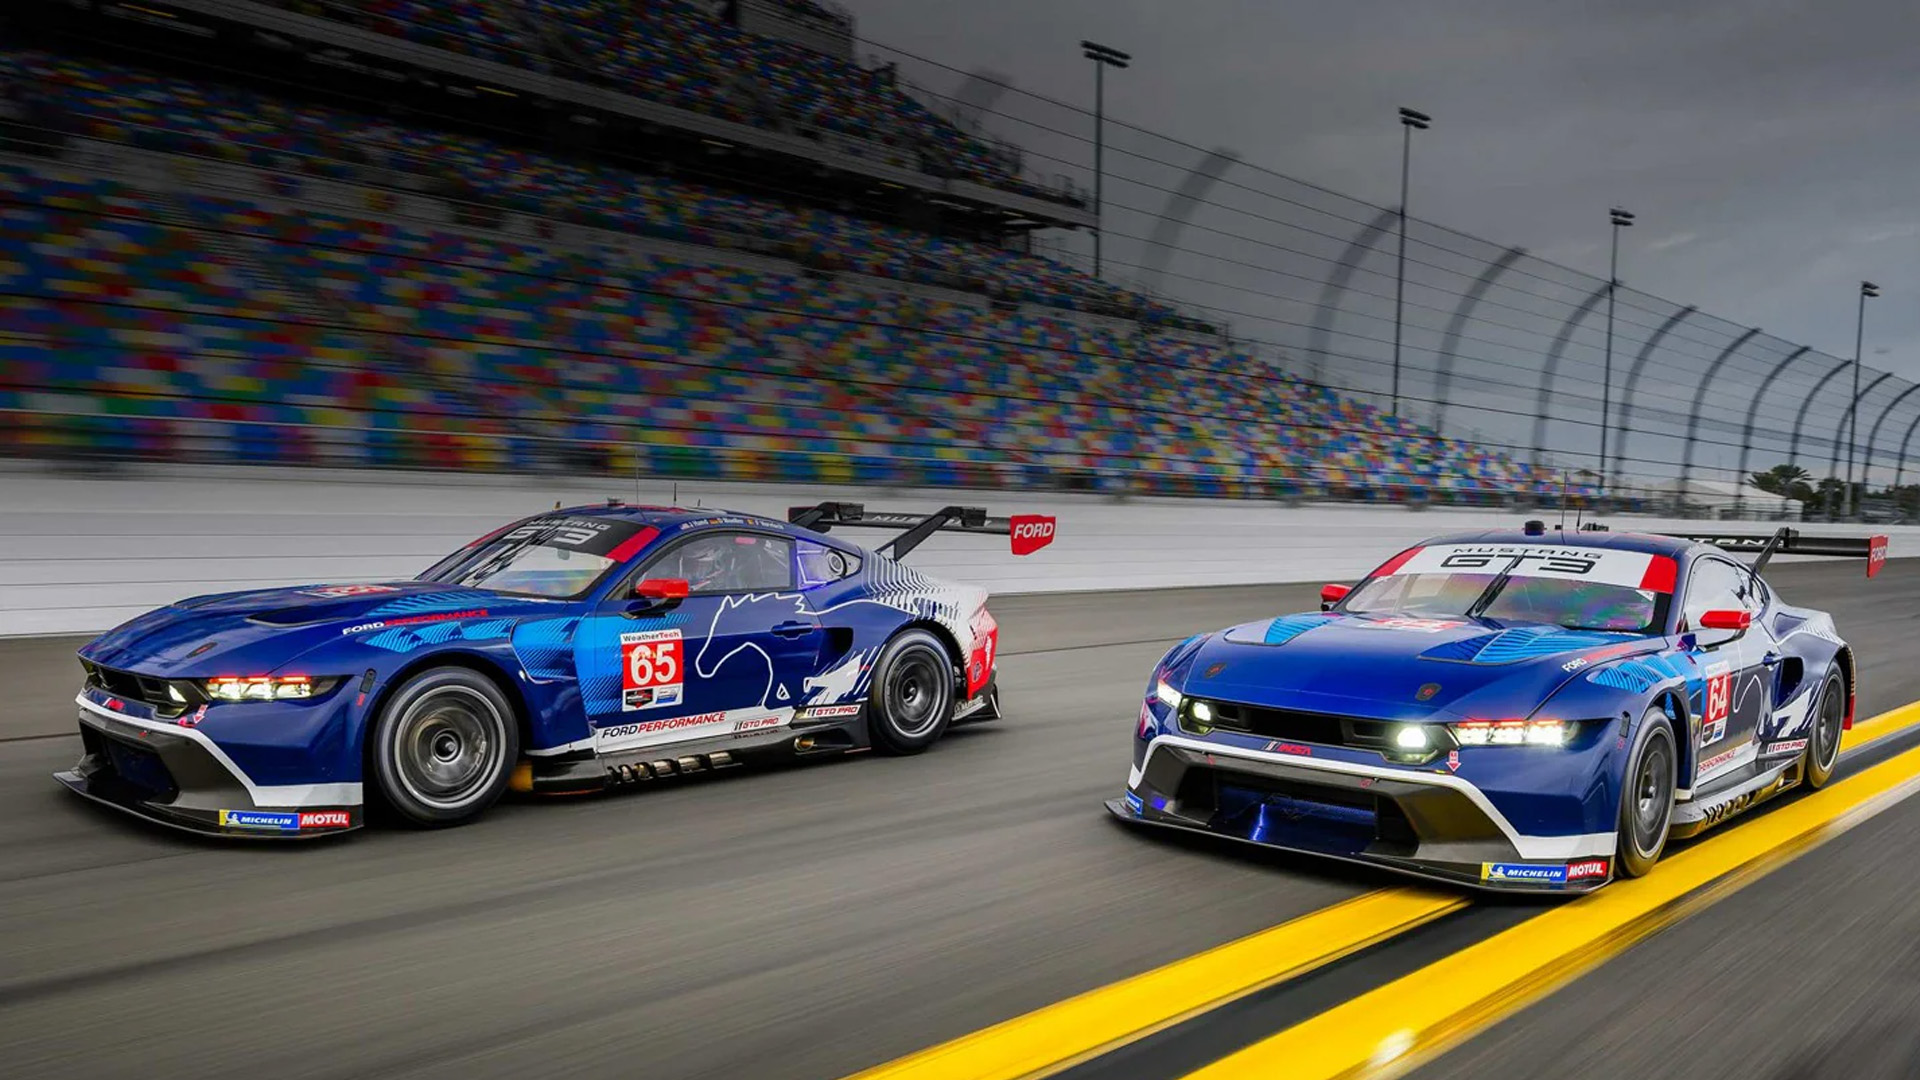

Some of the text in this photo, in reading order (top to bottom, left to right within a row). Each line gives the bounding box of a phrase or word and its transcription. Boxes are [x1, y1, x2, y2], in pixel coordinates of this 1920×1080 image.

[1013, 522, 1054, 540] FORD
[1453, 547, 1603, 559] MUSTANG
[1440, 554, 1596, 575] GT3
[622, 631, 680, 642] WeatherTech
[630, 643, 677, 686] 65
[1708, 675, 1728, 721] 64
[240, 813, 348, 825] MICHELIN MOTUL
[1507, 863, 1604, 878] MICHELIN MOTUL
